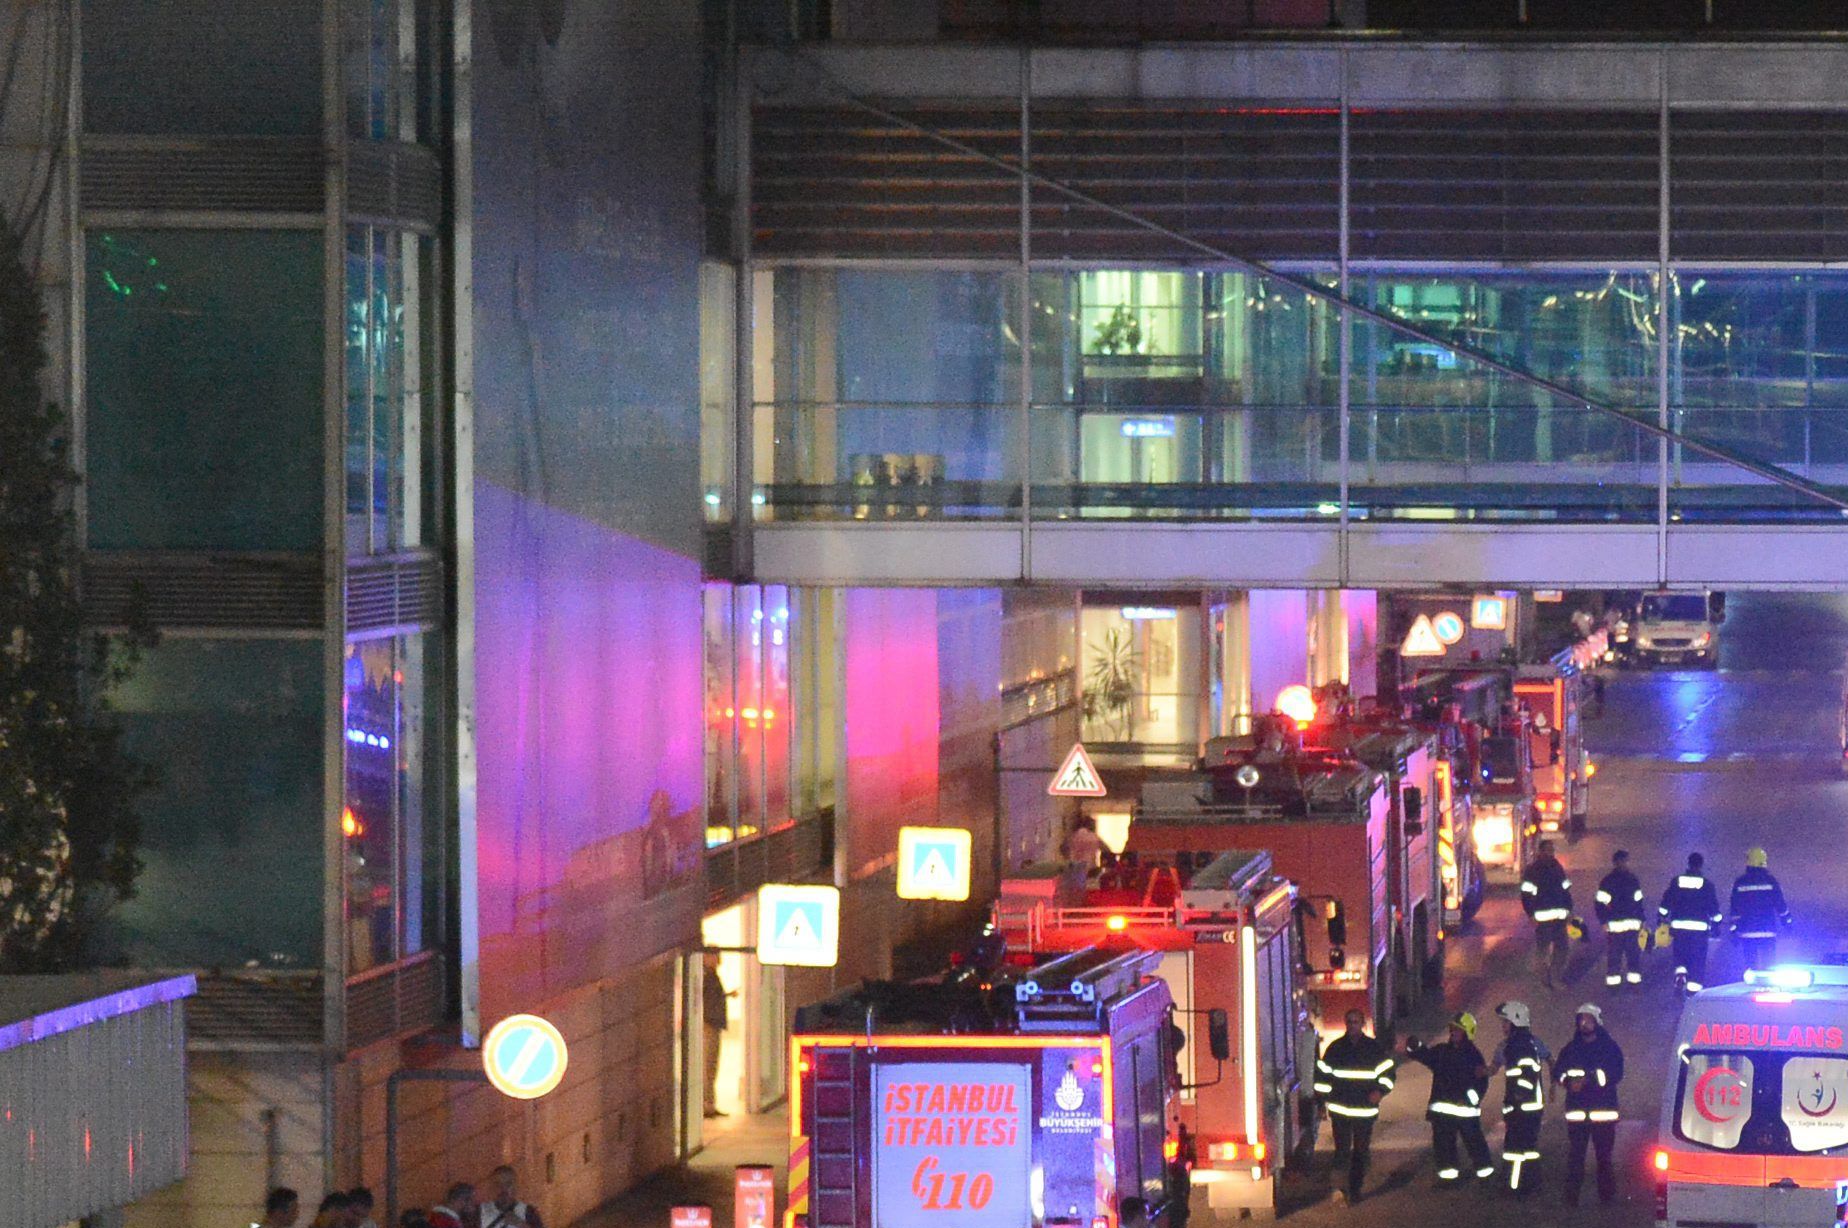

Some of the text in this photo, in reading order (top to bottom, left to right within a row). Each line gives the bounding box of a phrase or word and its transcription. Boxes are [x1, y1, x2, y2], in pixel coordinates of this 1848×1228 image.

[1693, 1023, 1844, 1049] AMBULANS
[1708, 1085, 1743, 1107] 112
[921, 1172, 994, 1211] 110
